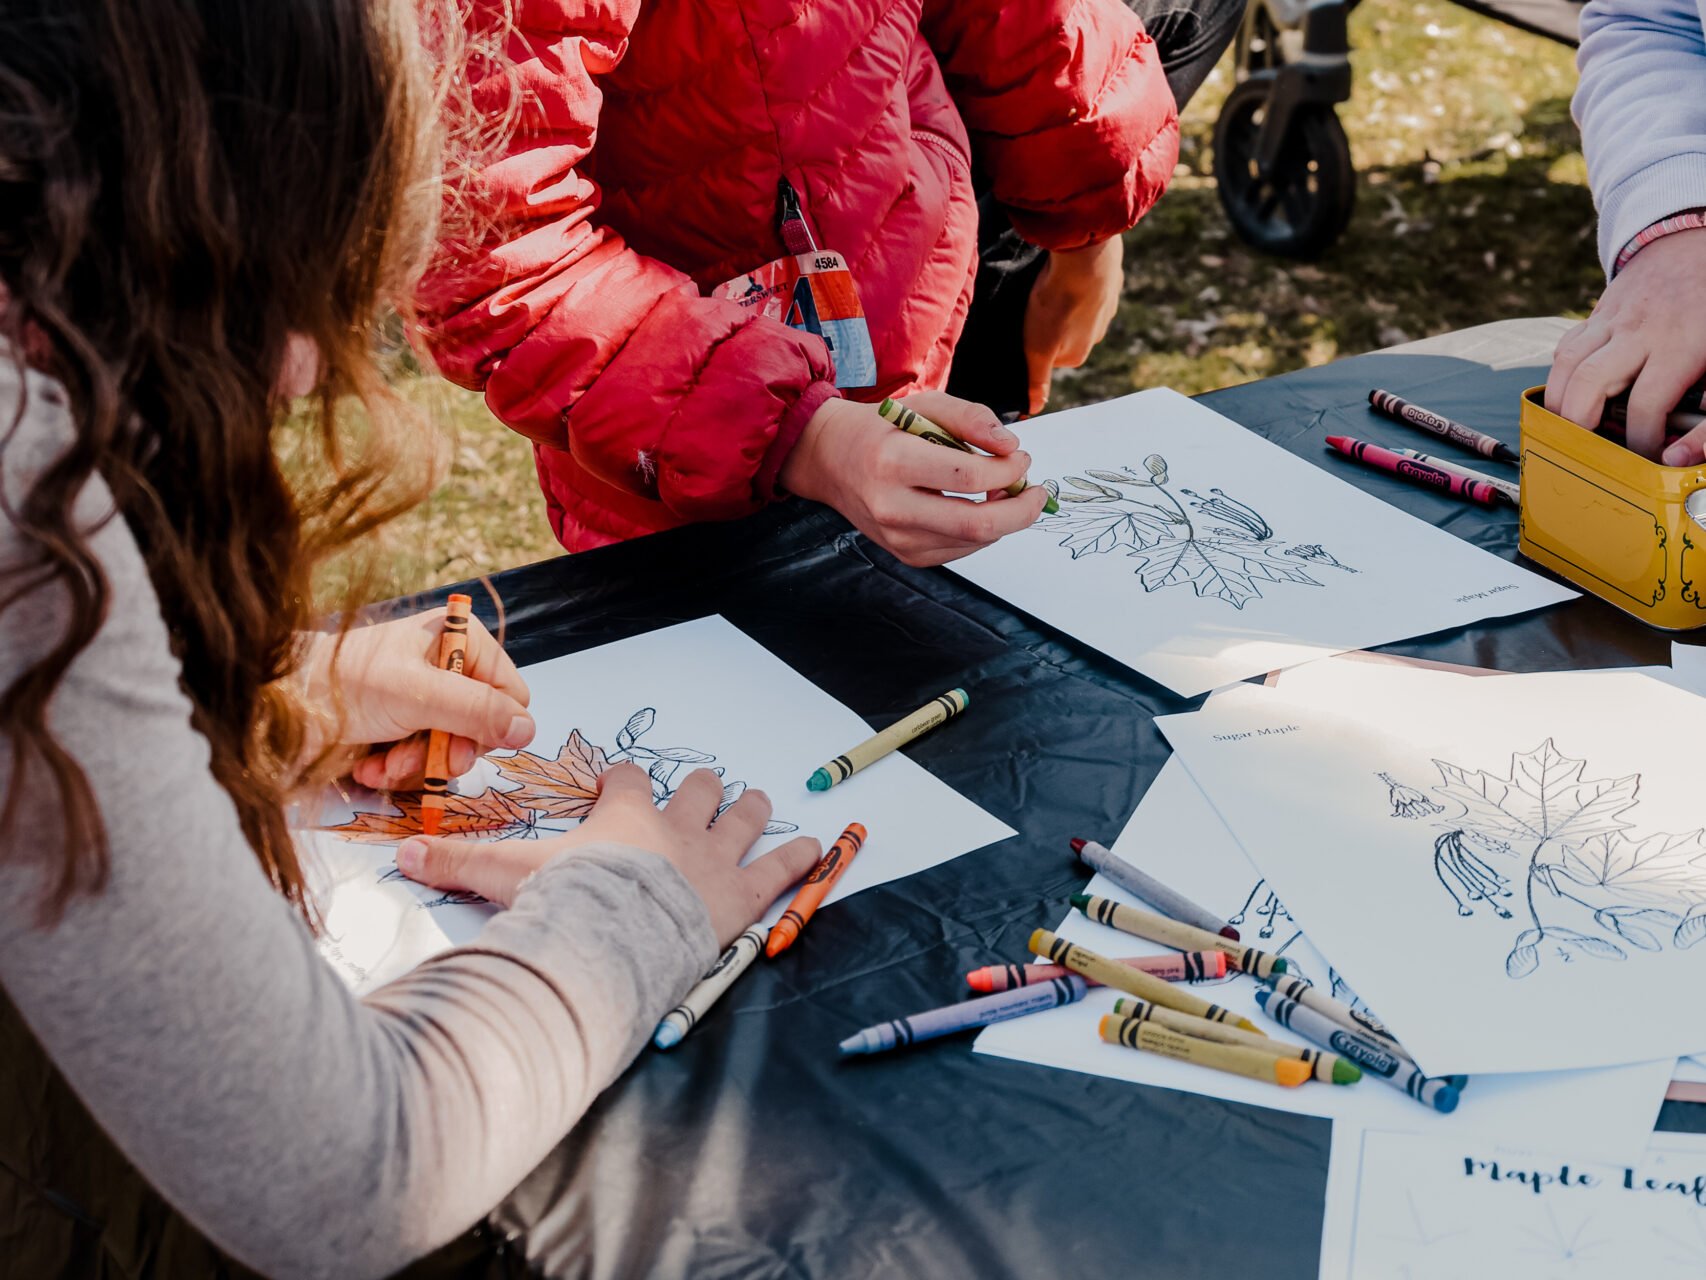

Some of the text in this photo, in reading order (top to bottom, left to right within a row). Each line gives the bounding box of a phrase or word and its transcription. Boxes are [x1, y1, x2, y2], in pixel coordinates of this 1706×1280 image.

[815, 256, 839, 270] 4584
[1407, 408, 1447, 433] Crayola
[1399, 461, 1446, 487] Crayola
[1488, 583, 1520, 595] Sugar
[1211, 724, 1301, 742] Sugar Maple
[1334, 1031, 1393, 1073] Crayola
[1464, 1157, 1706, 1207] Maple Leaf
